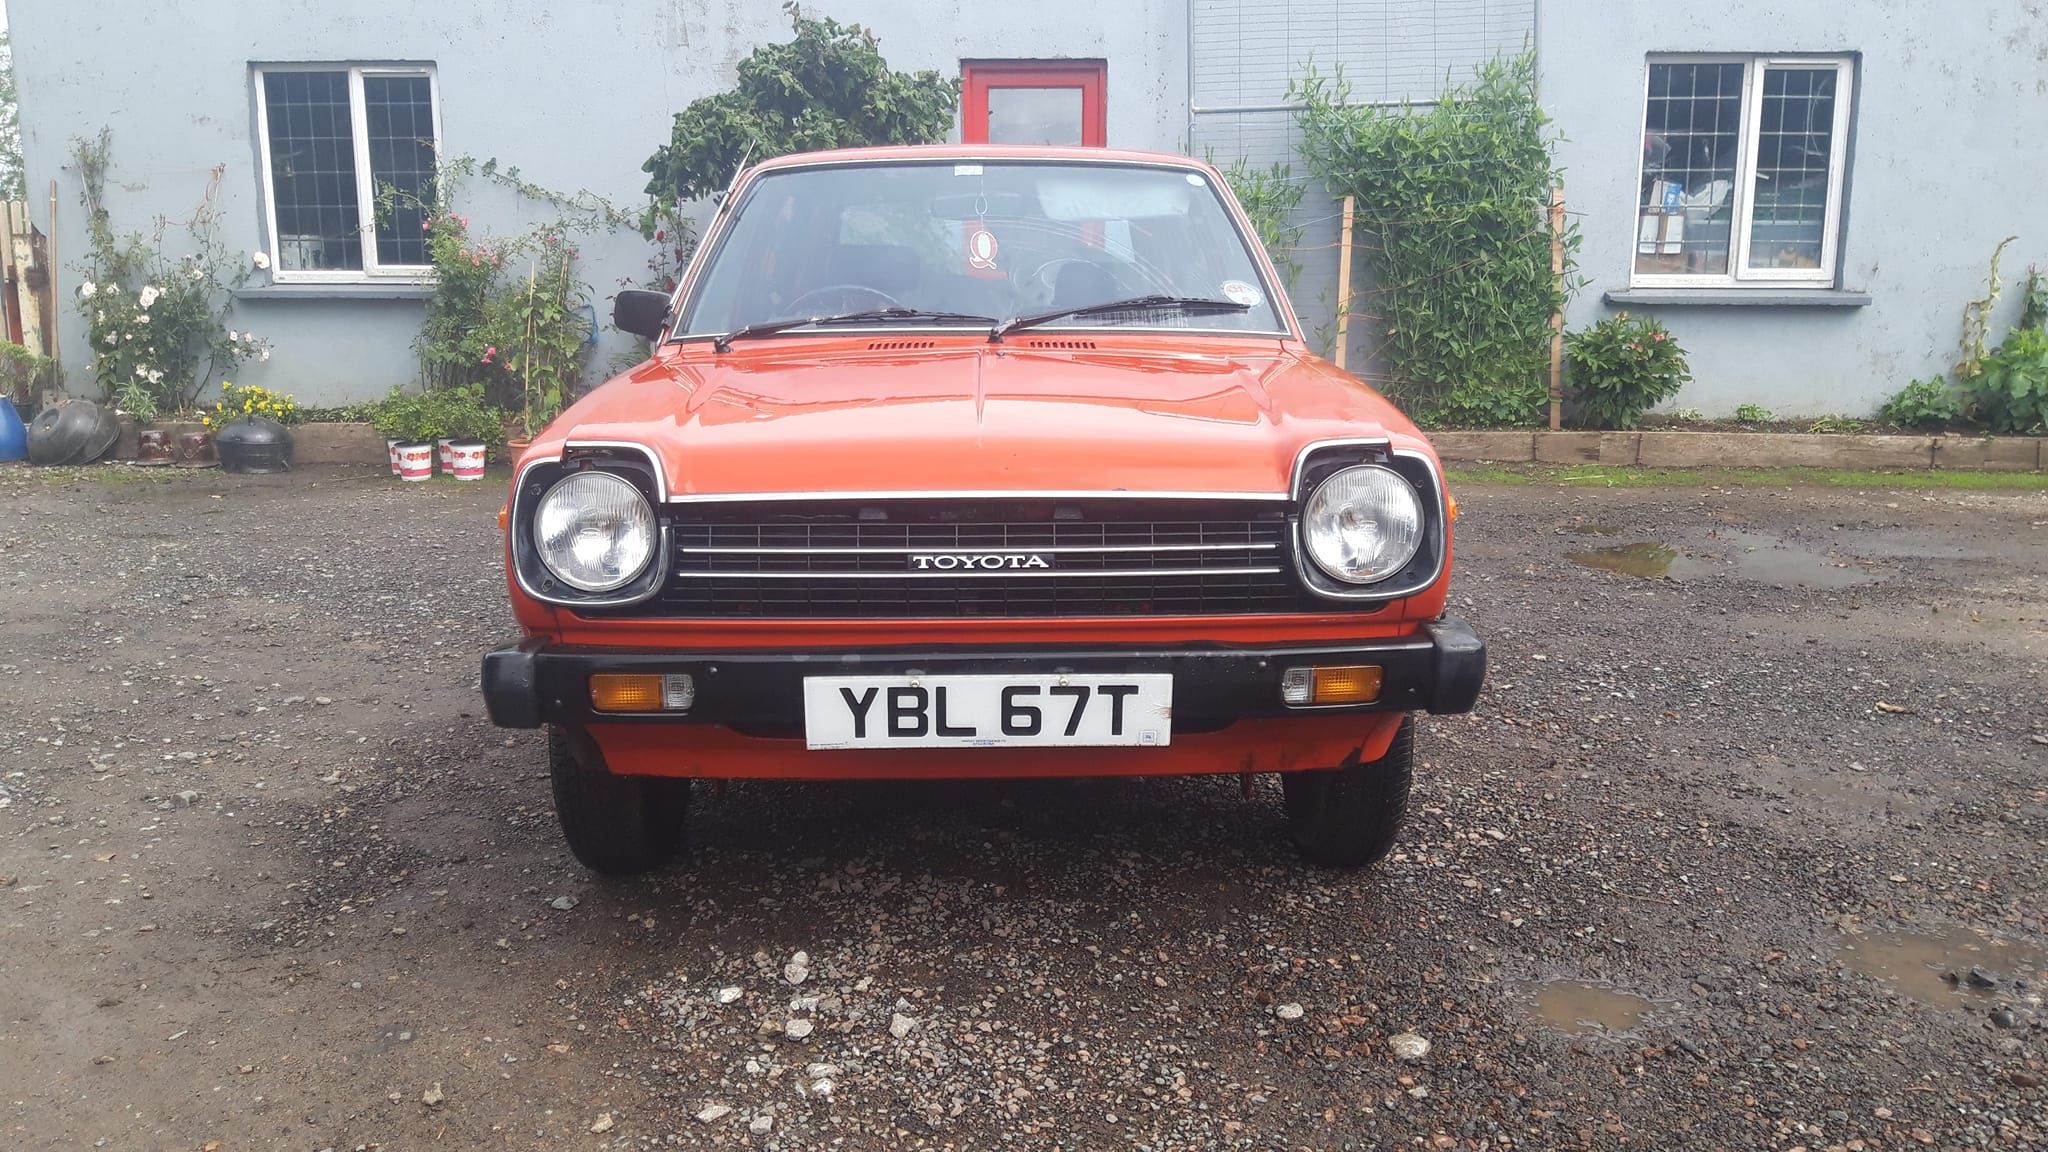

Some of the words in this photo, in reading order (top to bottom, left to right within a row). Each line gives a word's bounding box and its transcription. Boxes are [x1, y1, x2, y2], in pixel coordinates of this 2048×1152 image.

[912, 554, 1050, 570] TOYOTA
[838, 686, 977, 739] YBL
[1000, 684, 1140, 738] 67T
